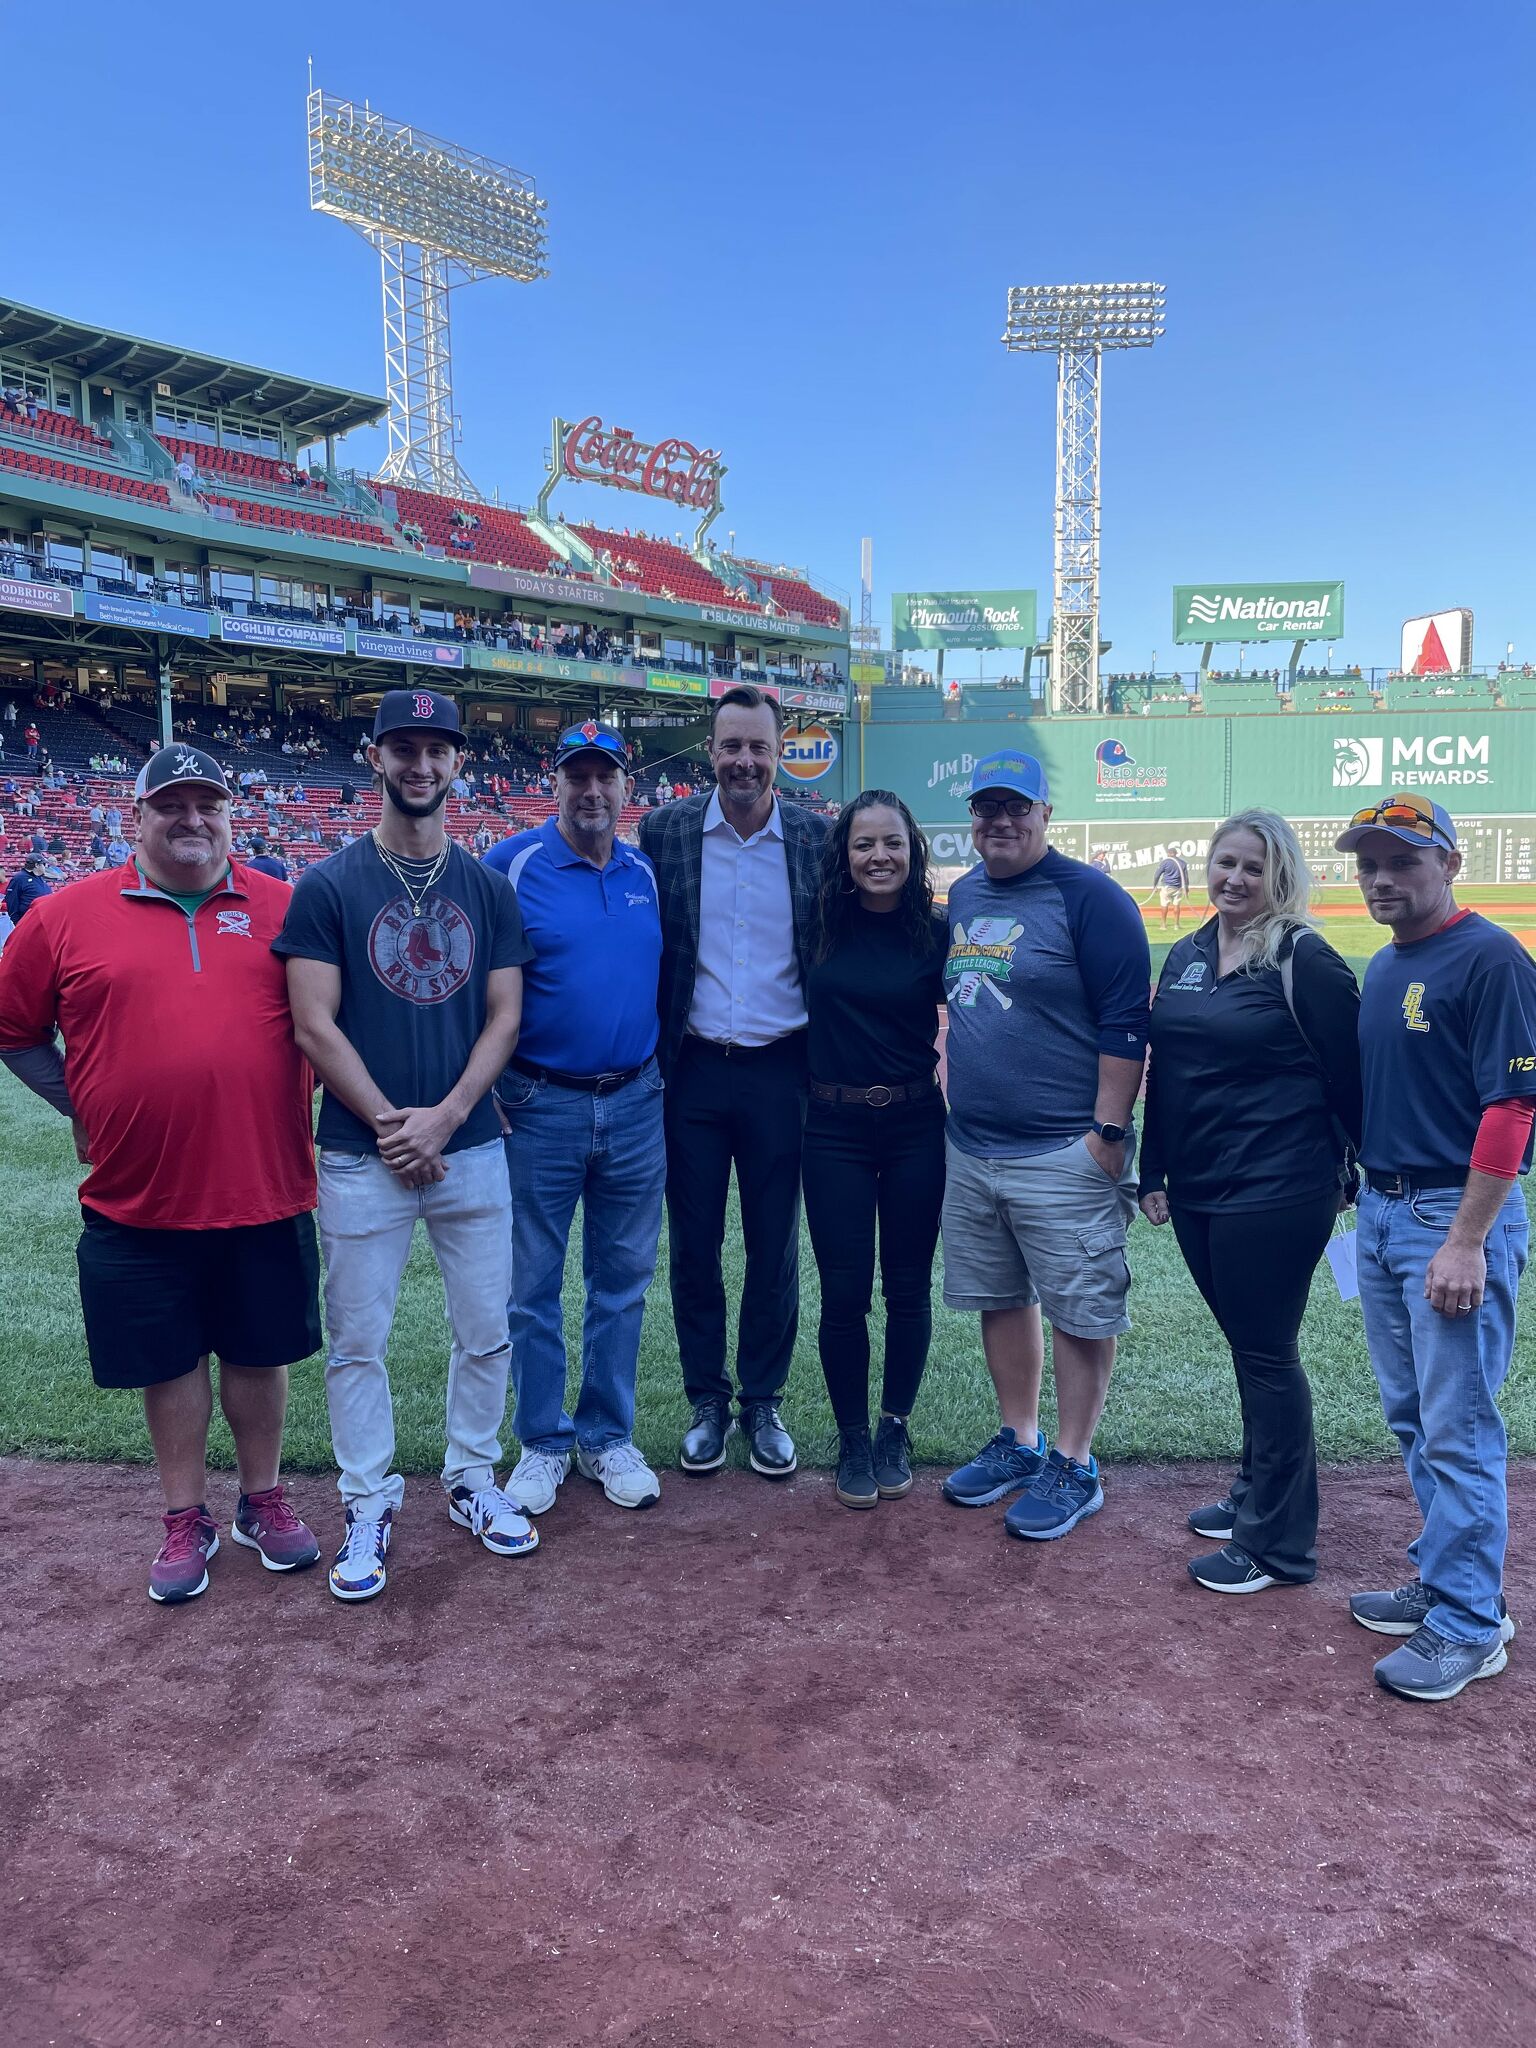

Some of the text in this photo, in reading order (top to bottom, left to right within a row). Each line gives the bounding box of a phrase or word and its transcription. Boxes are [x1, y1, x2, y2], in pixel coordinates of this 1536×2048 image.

[0, 584, 62, 602] ODBRIDGE
[514, 577, 605, 603] TODAY'S STARTERS
[100, 612, 194, 633] Beth Israel Deaconess Medical Center
[715, 613, 801, 635] BLACK LIVES MATTER
[911, 607, 1020, 626] Plymouth Rock
[1257, 620, 1324, 632] Car Rental
[224, 620, 343, 644] COGHLIN COMPANIES
[360, 640, 405, 655] vineyard
[406, 645, 433, 658] vines
[218, 674, 226, 682] 30
[559, 664, 570, 676] VS
[412, 694, 434, 718] B
[805, 695, 845, 710] Safelite
[782, 740, 833, 760] Gulf
[1391, 735, 1490, 766] MGM
[172, 754, 203, 775] A
[927, 760, 959, 788] JIM
[1103, 766, 1168, 778] RED SOX
[1101, 777, 1167, 788] SCHOLARS
[1391, 769, 1489, 786] REWARDS
[932, 832, 982, 858] CV
[982, 945, 1014, 960] COUNTY
[953, 959, 1001, 972] LITTLE LEAGUE
[384, 961, 464, 995] RED SOX
